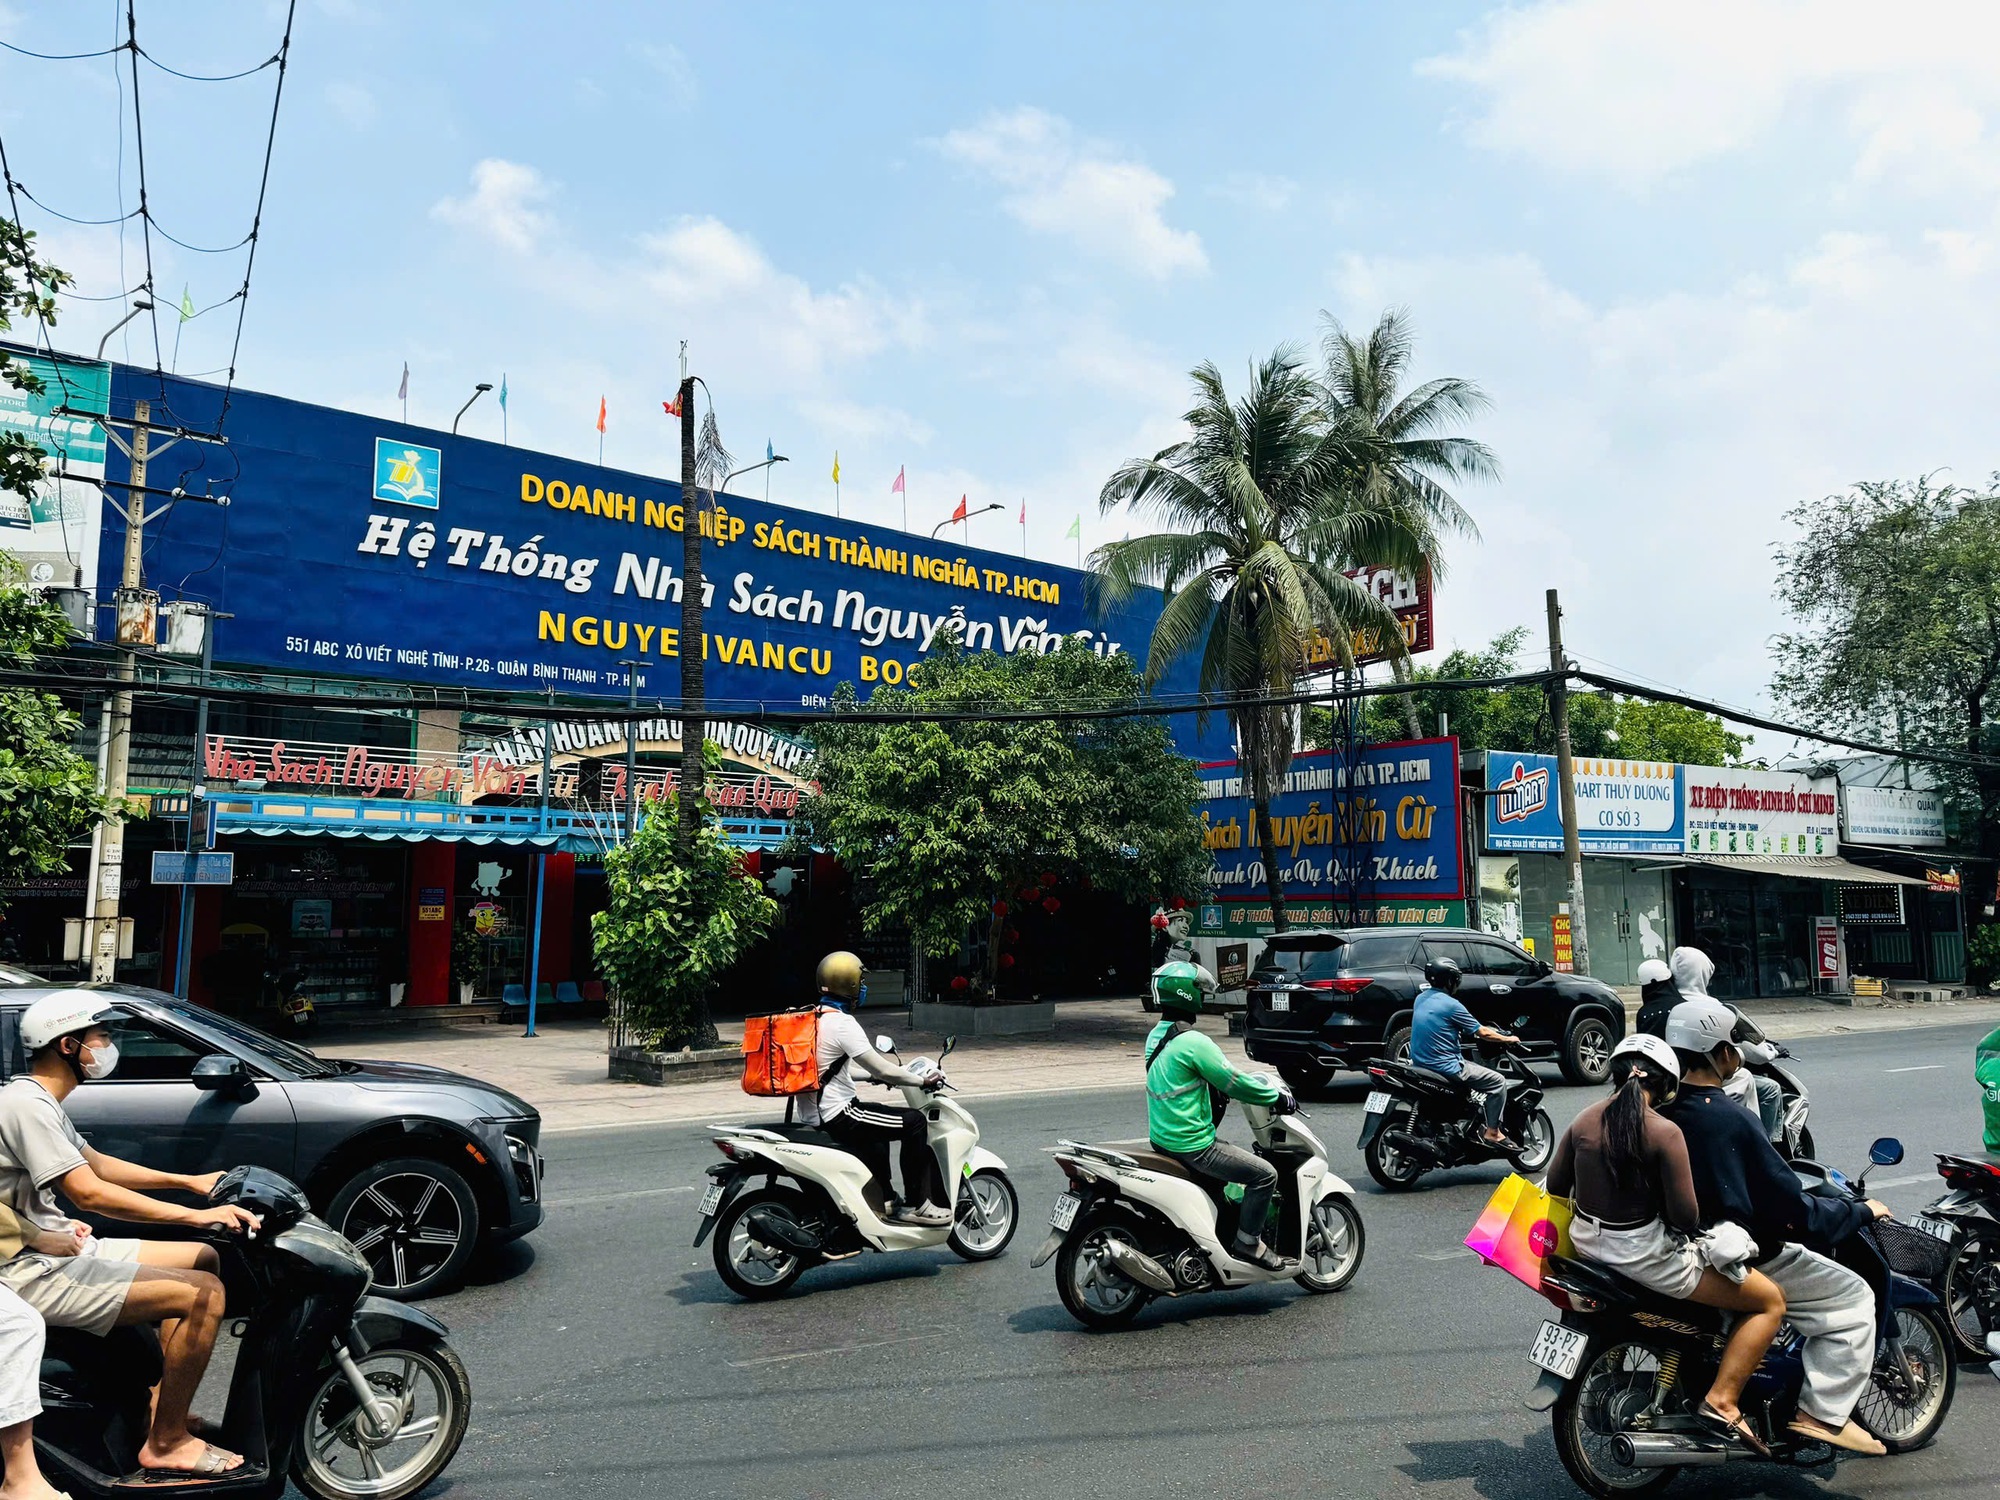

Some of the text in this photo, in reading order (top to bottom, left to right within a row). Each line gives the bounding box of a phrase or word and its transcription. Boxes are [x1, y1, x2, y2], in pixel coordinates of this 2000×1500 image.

[521, 473, 636, 523] DOANH
[753, 518, 820, 559] SÁCH
[825, 536, 908, 576] THÀNH
[912, 554, 980, 591] NGHĨA
[983, 569, 1060, 606] TP.HCM
[357, 514, 437, 569] Hệ
[447, 527, 600, 594] Thống
[613, 552, 715, 609] Nhà
[727, 571, 824, 625] Sách
[832, 588, 995, 653] Nguyễn
[286, 636, 310, 653] 551
[313, 638, 339, 656] ABC
[345, 643, 363, 660] XÔ
[366, 644, 392, 663] VIẾT
[397, 648, 429, 668] NGHỆ
[497, 659, 528, 678] QUẬN
[533, 662, 559, 680] BÌNH
[562, 667, 597, 685] THẠNH
[204, 736, 257, 780] Nhà
[265, 741, 333, 785] Sách
[341, 746, 464, 799] Nguyễn
[471, 754, 526, 795] Văn
[752, 774, 799, 817] Quý
[1294, 766, 1333, 791] THÀNH
[1377, 758, 1431, 785] TP.HCM
[1690, 786, 1704, 808] XE
[1704, 781, 1729, 817] ĐIỆN
[1730, 782, 1760, 811] THÔNG
[1760, 790, 1783, 812] MINH
[1797, 787, 1813, 814] CHÍ
[1812, 793, 1835, 815] MINH
[1396, 795, 1437, 841] Cừ
[1617, 806, 1632, 826] SỞ
[1633, 811, 1640, 827] 3
[1294, 858, 1323, 887] Vụ
[1370, 855, 1440, 881] Khách
[1229, 908, 1245, 925] HỆ
[1247, 906, 1275, 923] THỐN
[1287, 905, 1309, 923] NHÀ
[1397, 906, 1425, 923] VĂN
[1426, 904, 1450, 923] CỪ
[1555, 918, 1571, 930] CHO
[1176, 988, 1193, 1002] Grab
[1115, 1169, 1156, 1184] VISION
[1532, 1231, 1555, 1250] sunsilk
[1543, 1325, 1579, 1354] 93-P2
[1531, 1342, 1577, 1376] 418.70
